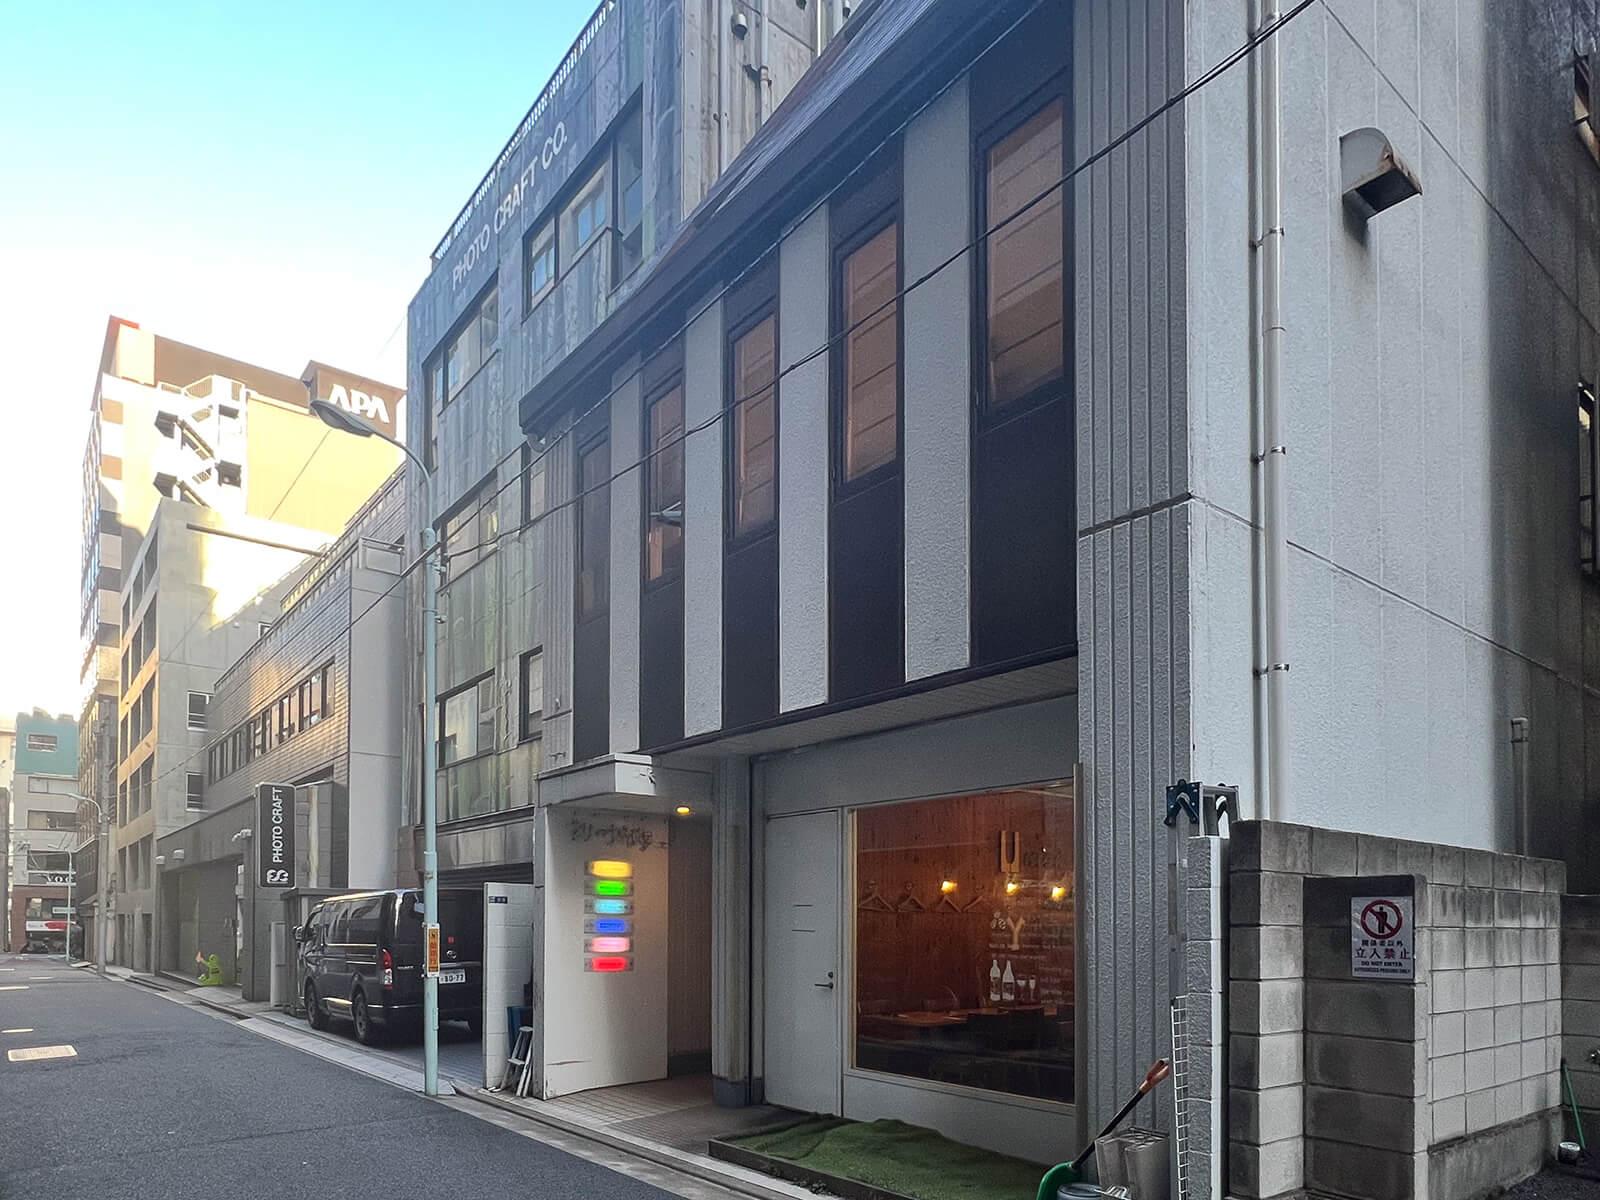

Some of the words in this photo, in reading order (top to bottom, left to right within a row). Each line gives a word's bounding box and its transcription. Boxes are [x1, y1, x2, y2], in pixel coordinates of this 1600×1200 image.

[452, 223, 490, 291] PHOTO
[494, 155, 538, 235] CRAFT
[542, 121, 568, 170] CO.
[328, 383, 390, 424] APA
[272, 787, 283, 824] CRAFT
[272, 826, 283, 863] PHOTO
[1355, 948, 1411, 960] 立入禁止
